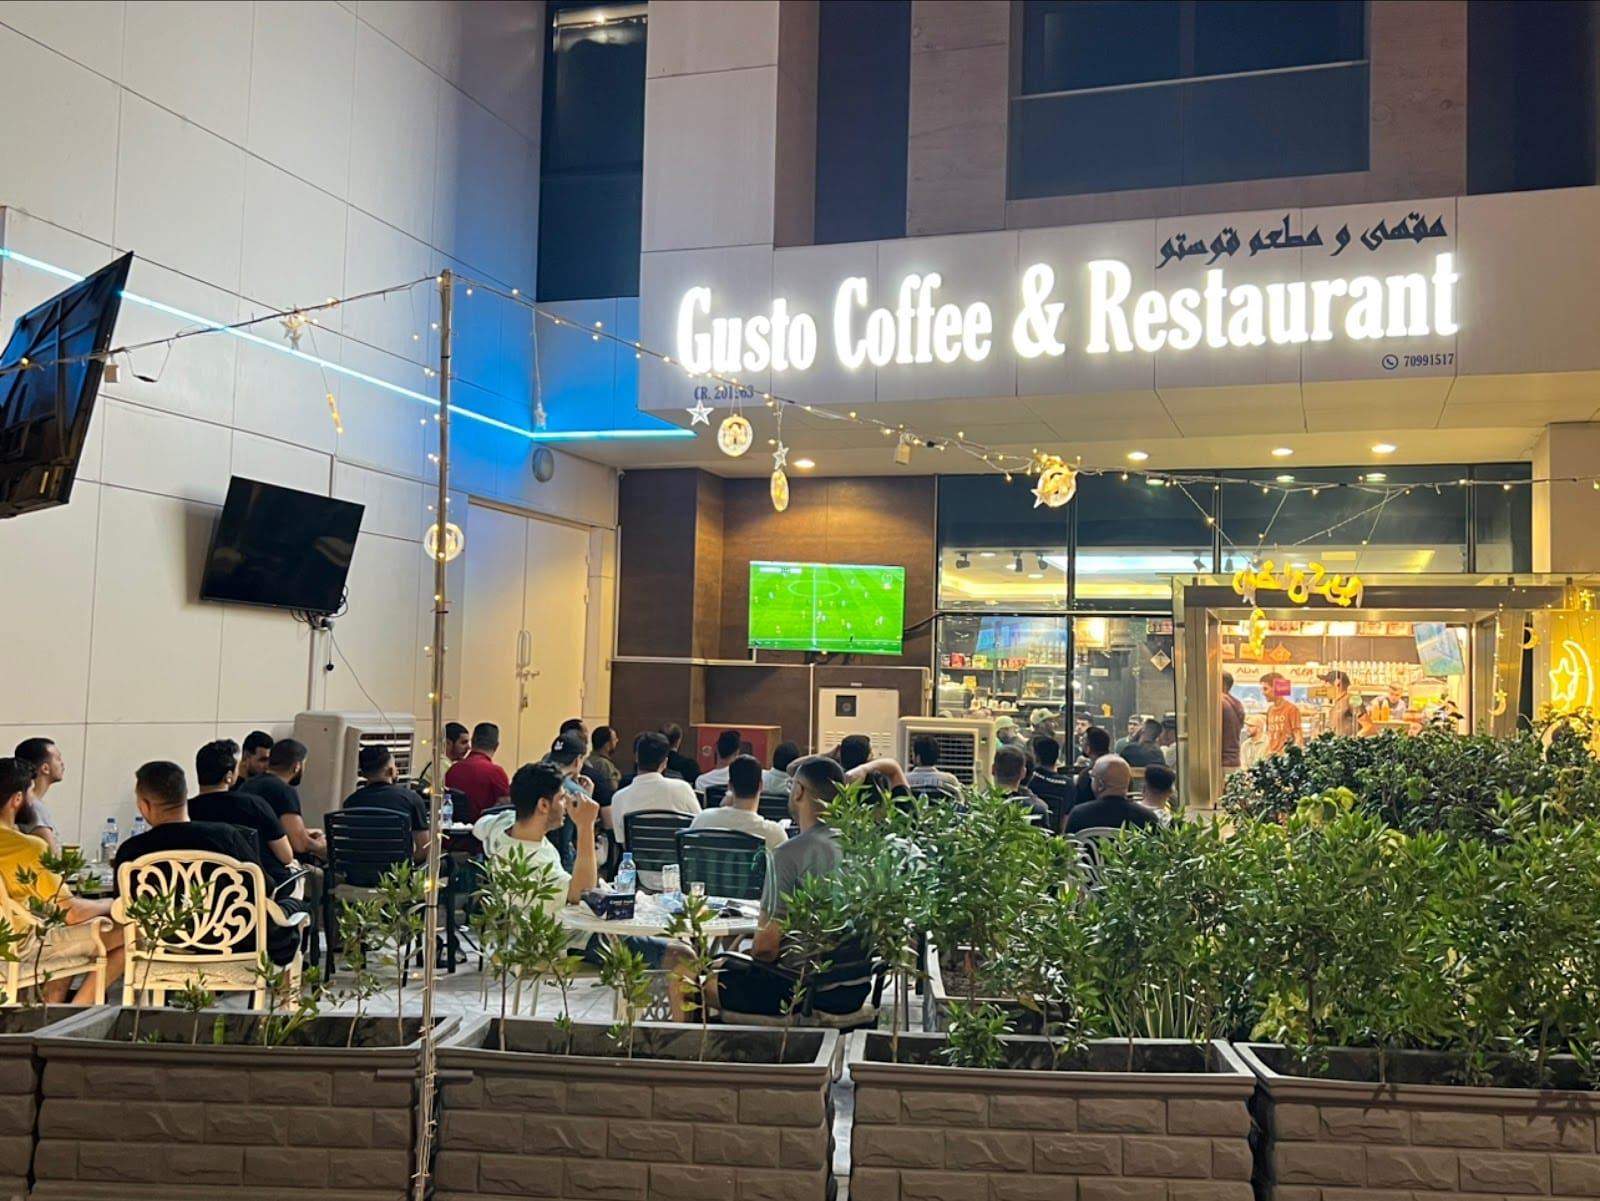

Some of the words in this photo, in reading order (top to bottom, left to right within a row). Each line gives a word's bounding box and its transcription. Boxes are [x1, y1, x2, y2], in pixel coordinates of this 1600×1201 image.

[1330, 223, 1352, 257] و
[677, 286, 817, 374] Gusto
[833, 272, 993, 370] Coffee
[1012, 262, 1066, 359] &
[1085, 252, 1460, 353] Restaurant
[1403, 353, 1455, 367] 70991517
